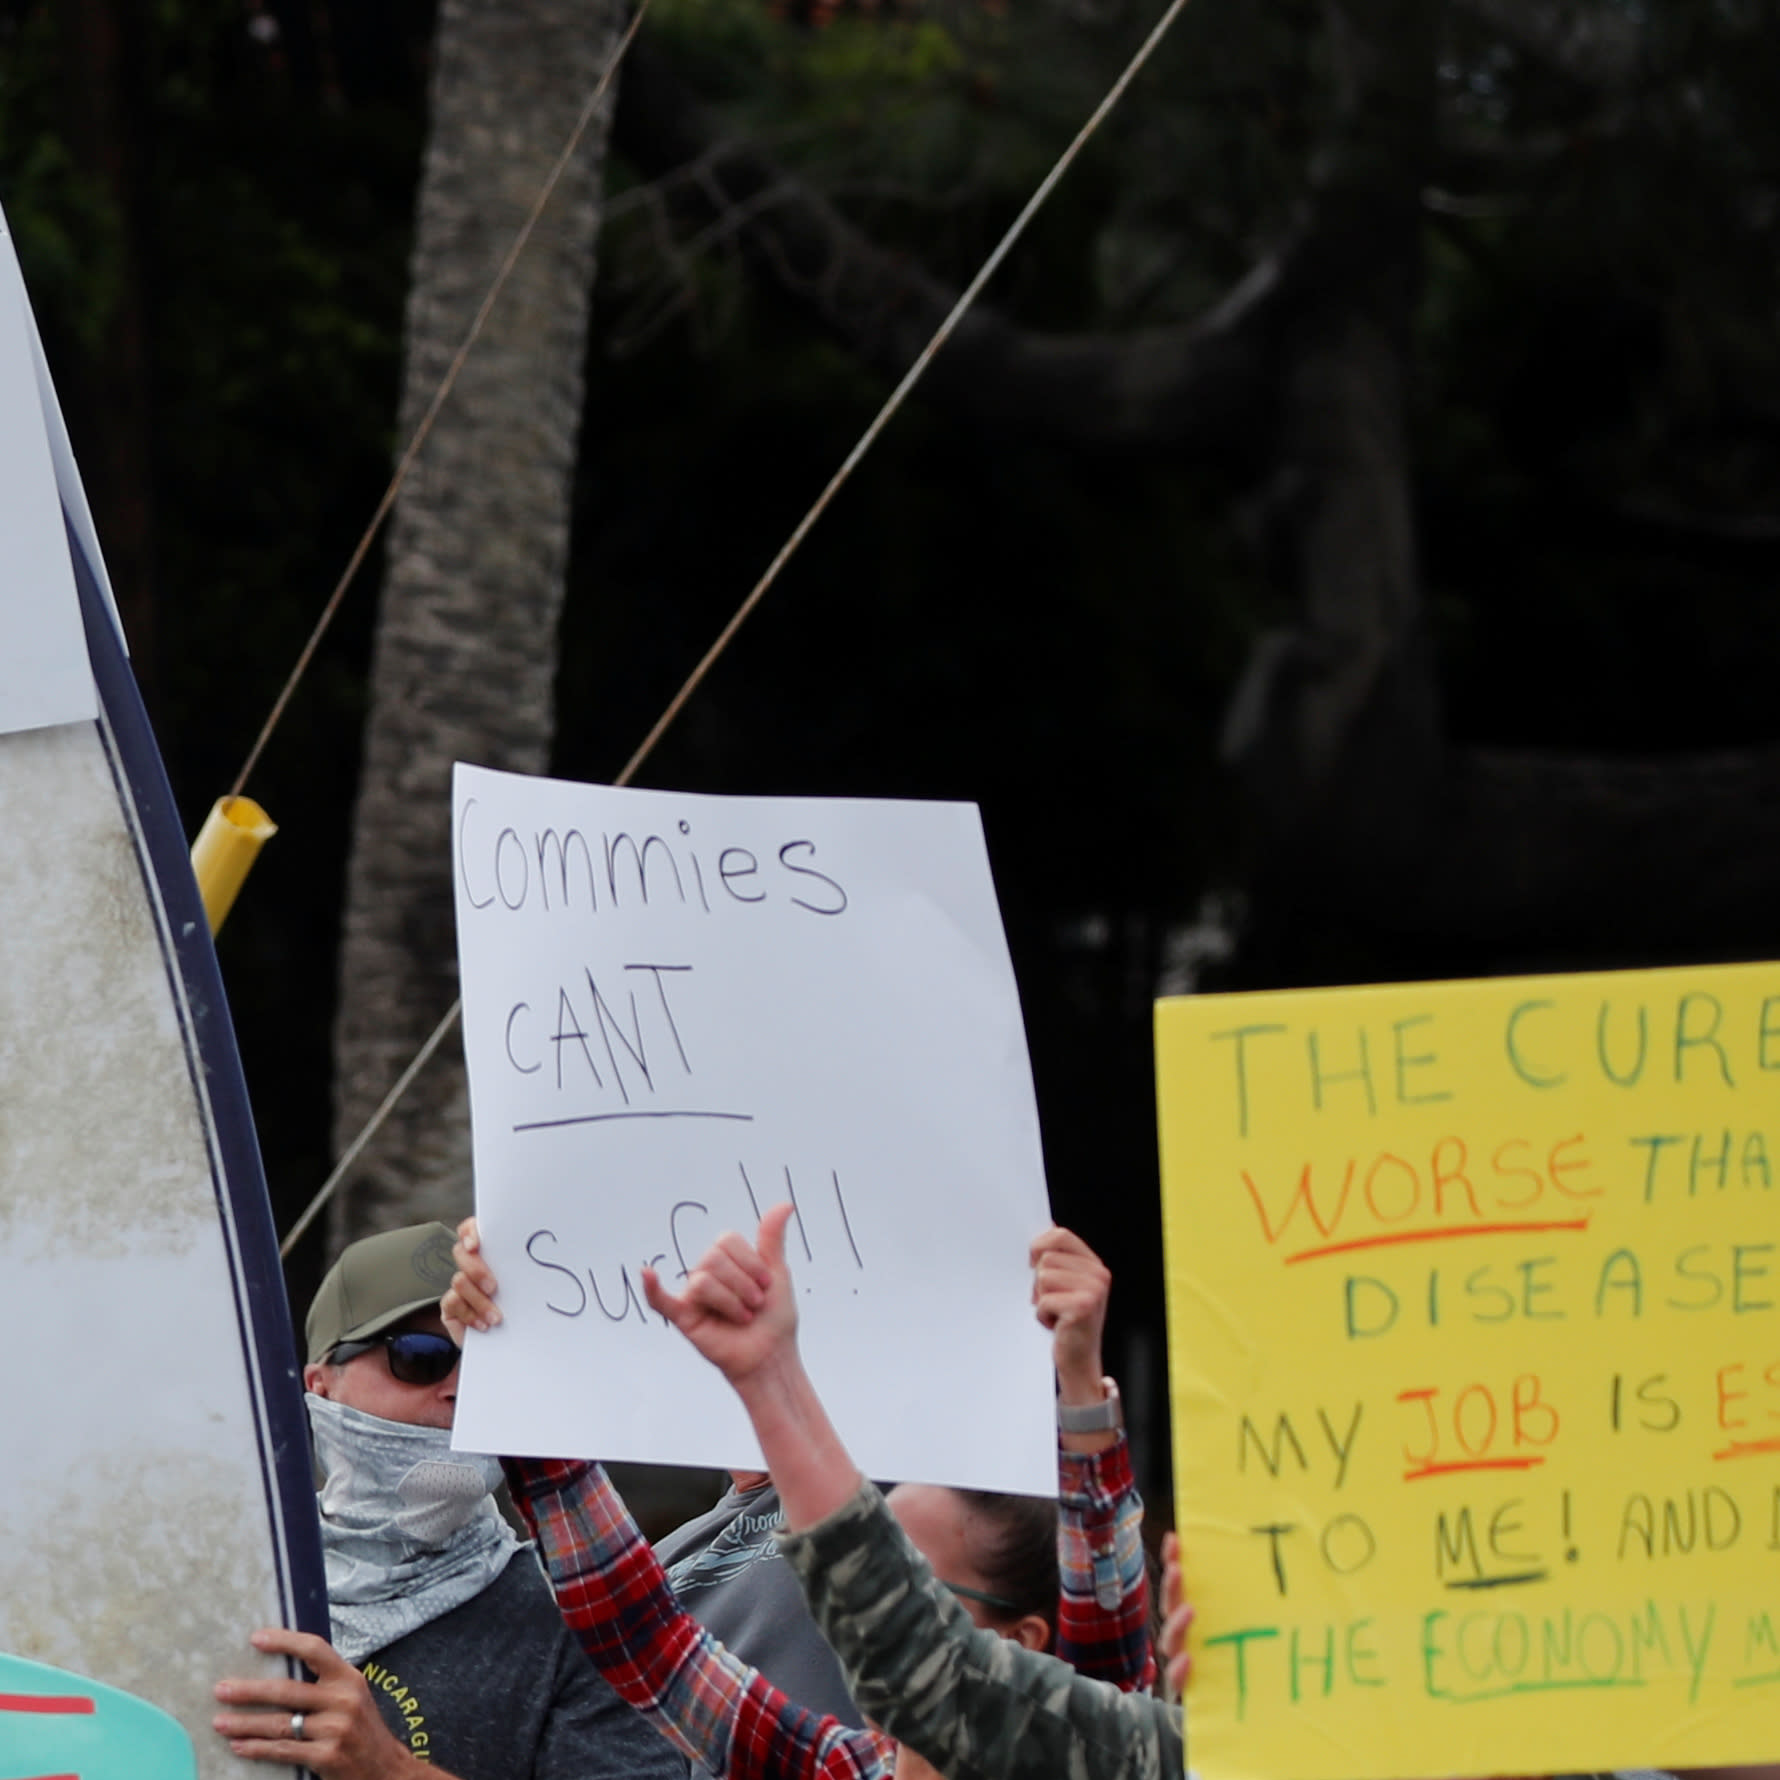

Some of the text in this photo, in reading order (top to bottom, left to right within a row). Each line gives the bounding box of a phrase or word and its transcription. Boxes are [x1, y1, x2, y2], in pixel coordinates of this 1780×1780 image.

[1209, 1012, 1454, 1139] THE
[1240, 1133, 1605, 1248] WORSE
[1344, 1244, 1776, 1342] DISEASE
[1239, 1401, 1363, 1490] MY
[1395, 1373, 1561, 1466] JOB
[1611, 1372, 1681, 1434] IS
[1250, 1511, 1378, 1598] TO
[1616, 1485, 1743, 1562] AND
[1204, 1617, 1388, 1724] THE
[1422, 1597, 1717, 1706] ECONOMY
